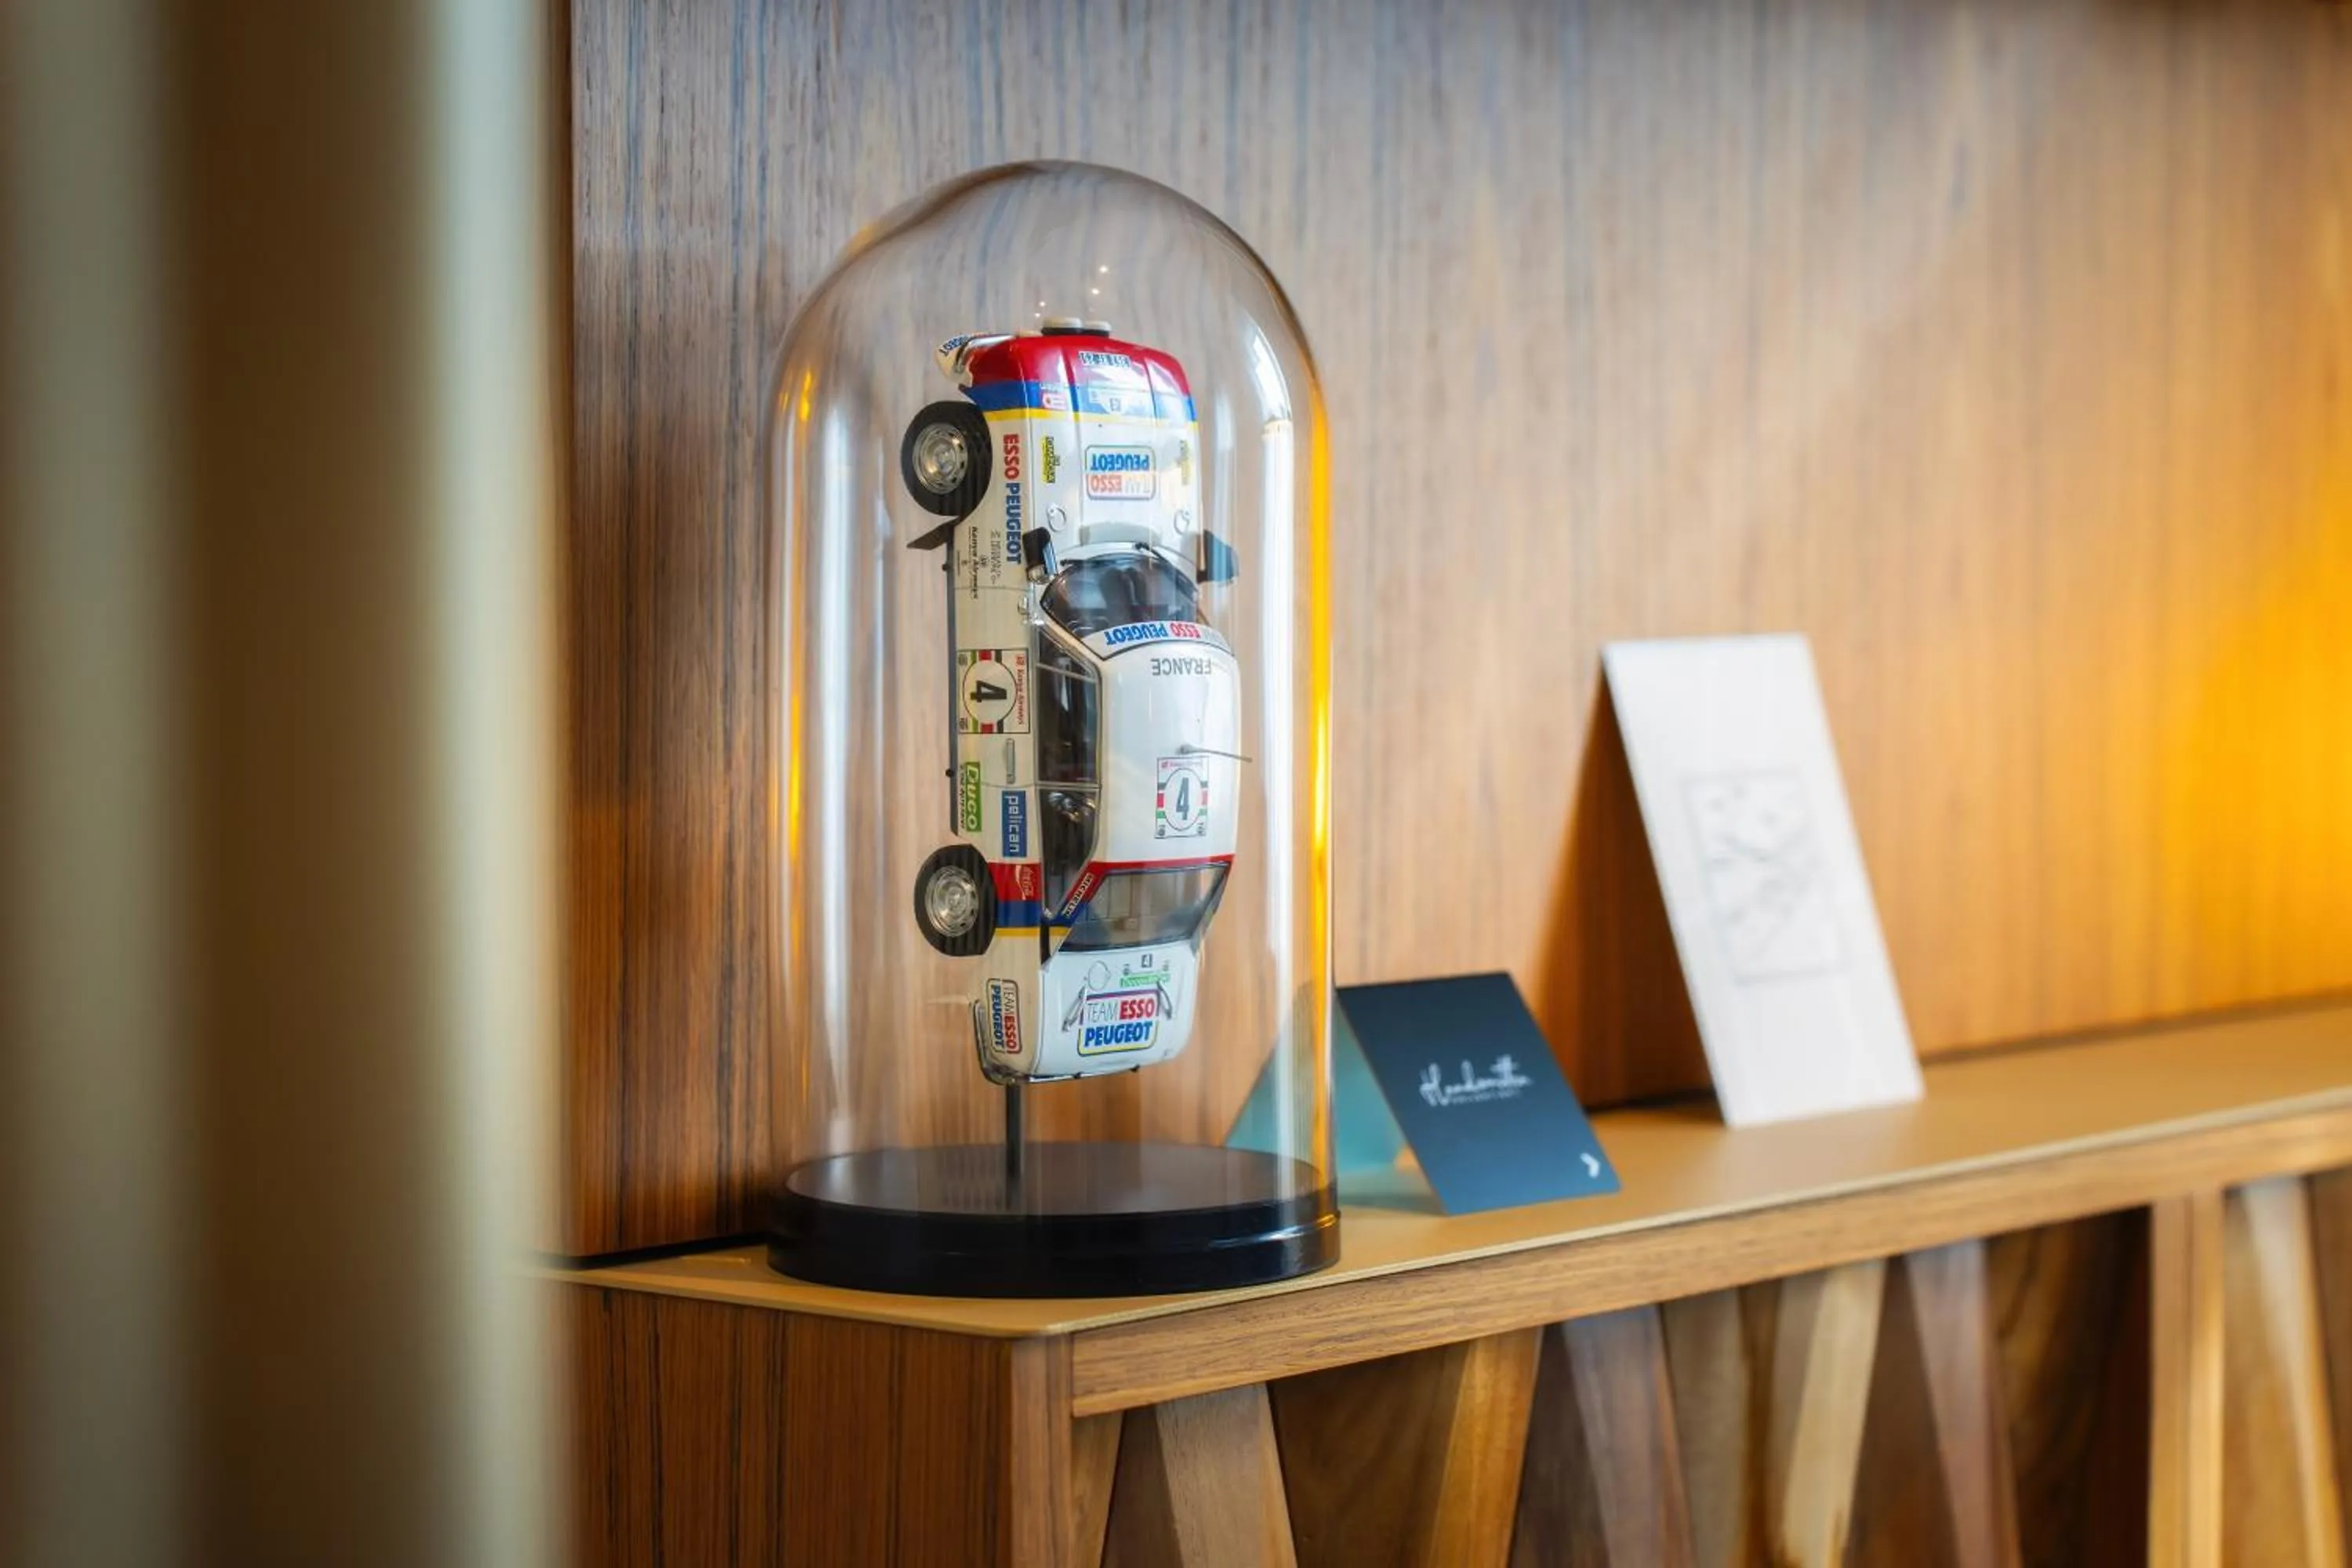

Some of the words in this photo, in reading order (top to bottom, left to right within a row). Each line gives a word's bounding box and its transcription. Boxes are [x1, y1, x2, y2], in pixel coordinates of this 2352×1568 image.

[1004, 434, 1019, 480] ESSO
[1091, 453, 1149, 471] PEUGEOT
[1091, 475, 1122, 493] ESSO
[1006, 482, 1022, 564] PEUGEOT
[1104, 623, 1170, 646] PEUGEOT
[1171, 623, 1201, 640] ESSO
[1150, 658, 1212, 676] FRANCE
[971, 680, 1007, 703] 4
[1175, 777, 1189, 821] 4
[1004, 795, 1023, 853] pelican
[1003, 985, 1016, 1014] TEAM
[1087, 1001, 1119, 1023] TEAM
[1120, 998, 1155, 1020] ESSO
[990, 985, 1004, 1048] PEUGEOT
[1004, 1015, 1018, 1050] ESSO
[1084, 1022, 1153, 1047] PEUGEOT
